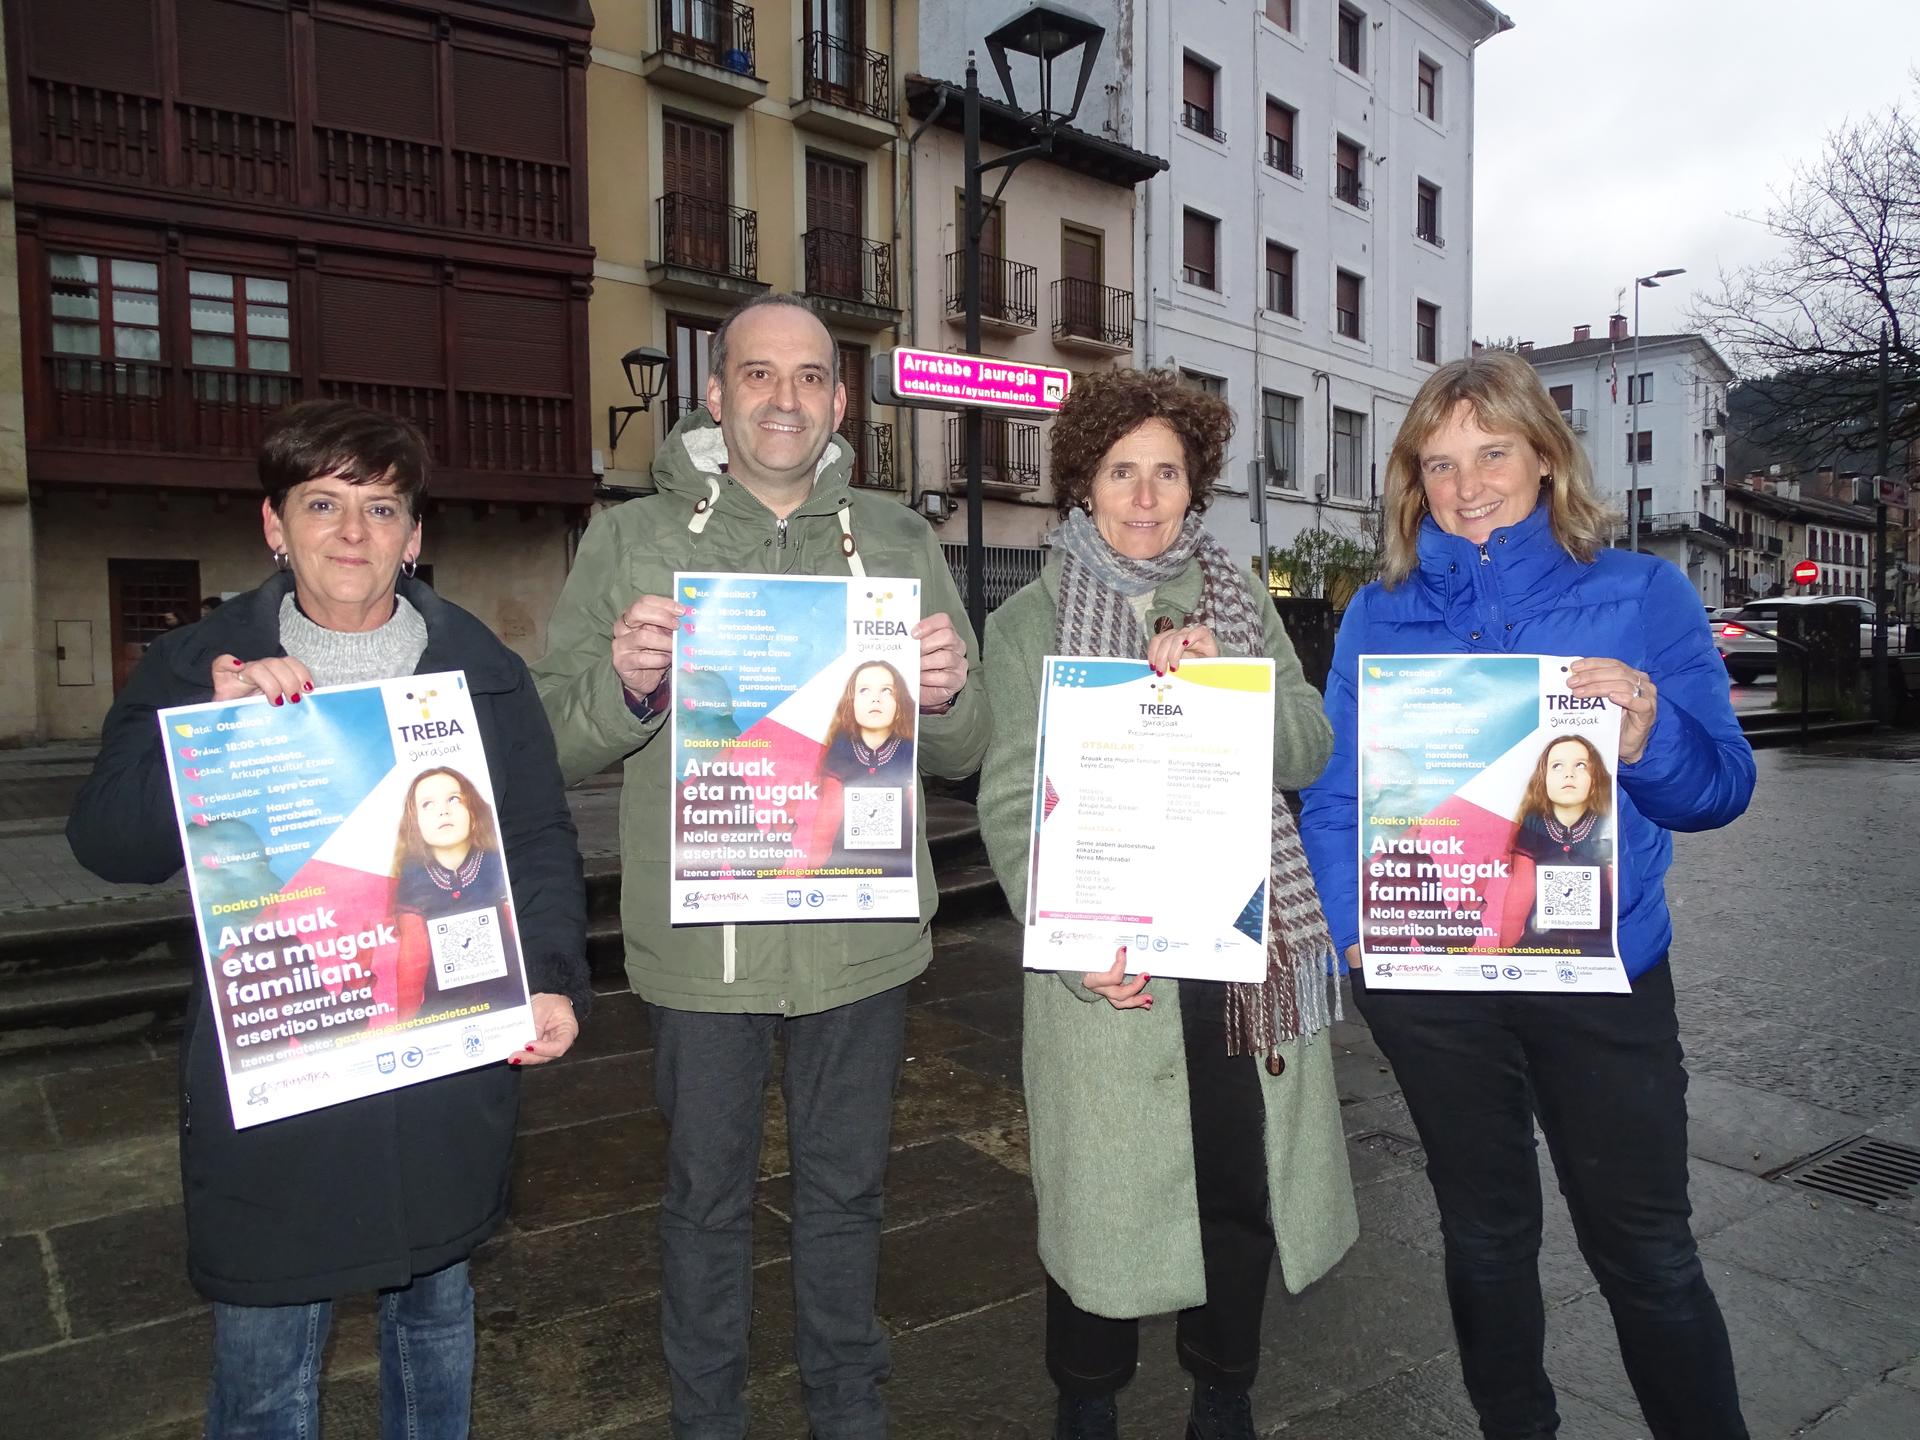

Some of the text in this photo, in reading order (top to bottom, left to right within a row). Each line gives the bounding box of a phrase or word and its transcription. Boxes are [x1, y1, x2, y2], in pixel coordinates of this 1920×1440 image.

[903, 354, 1037, 386] Arratabe jauregia
[853, 620, 908, 636] TREBA
[857, 641, 903, 652] gurasoak
[1140, 704, 1183, 716] TREBA
[1546, 694, 1606, 711] TREBA
[398, 719, 464, 742] TREBA
[1550, 716, 1600, 727] gurasoak
[408, 743, 462, 762] gurasoak
[684, 738, 772, 749] Doako hitzaldia:
[231, 767, 270, 780] Arkupe
[272, 763, 304, 775] Kultur
[684, 758, 776, 777] Arauak
[267, 782, 297, 795] Leyre
[299, 777, 329, 790] Cano
[683, 781, 818, 806] eta mugak
[683, 804, 794, 825] familian.
[1370, 816, 1460, 827] Doako hitzaldia:
[683, 830, 792, 843] Nola ezarri era
[1370, 836, 1464, 855] Arauak
[265, 841, 310, 855] Euskara
[683, 847, 807, 860] asertibo batean.
[684, 867, 883, 878] Izena emateko: gazteria@aretxabaleta.eus
[1370, 860, 1508, 885] eta mugak
[212, 886, 326, 916] Doako hitzaldia:
[1370, 882, 1483, 902] familian.
[1370, 908, 1481, 920] Nola ezarri era
[218, 906, 339, 950] Arauak
[1370, 924, 1497, 937] asertibo batean.
[222, 923, 397, 977] eta mugak
[1372, 945, 1581, 956] Izena emateko: gazteria@aretxabaleta.eus
[226, 960, 372, 1006] familian.
[232, 986, 373, 1028] Nola ezarri era
[236, 1002, 395, 1047] asertibo batean.
[240, 1053, 274, 1069] Izena
[276, 1039, 335, 1061] emateko:
[335, 1002, 491, 1048] gazteria@aretxabaleta.eus
